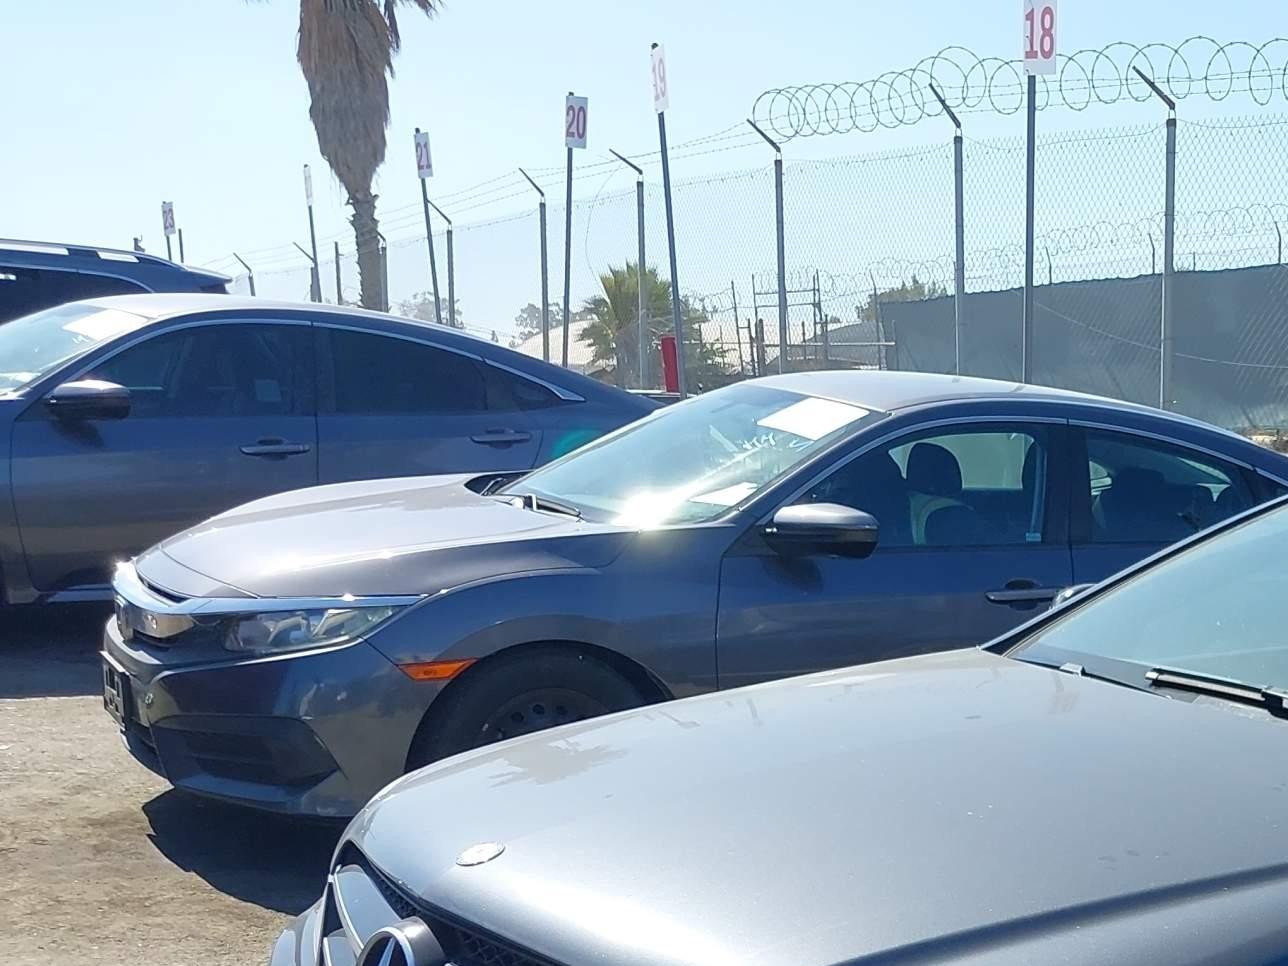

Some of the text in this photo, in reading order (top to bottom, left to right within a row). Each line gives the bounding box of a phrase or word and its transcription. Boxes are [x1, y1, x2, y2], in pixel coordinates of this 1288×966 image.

[1025, 6, 1054, 59] 18
[652, 57, 666, 101] 19
[566, 104, 586, 139] 20
[415, 141, 431, 170] 21
